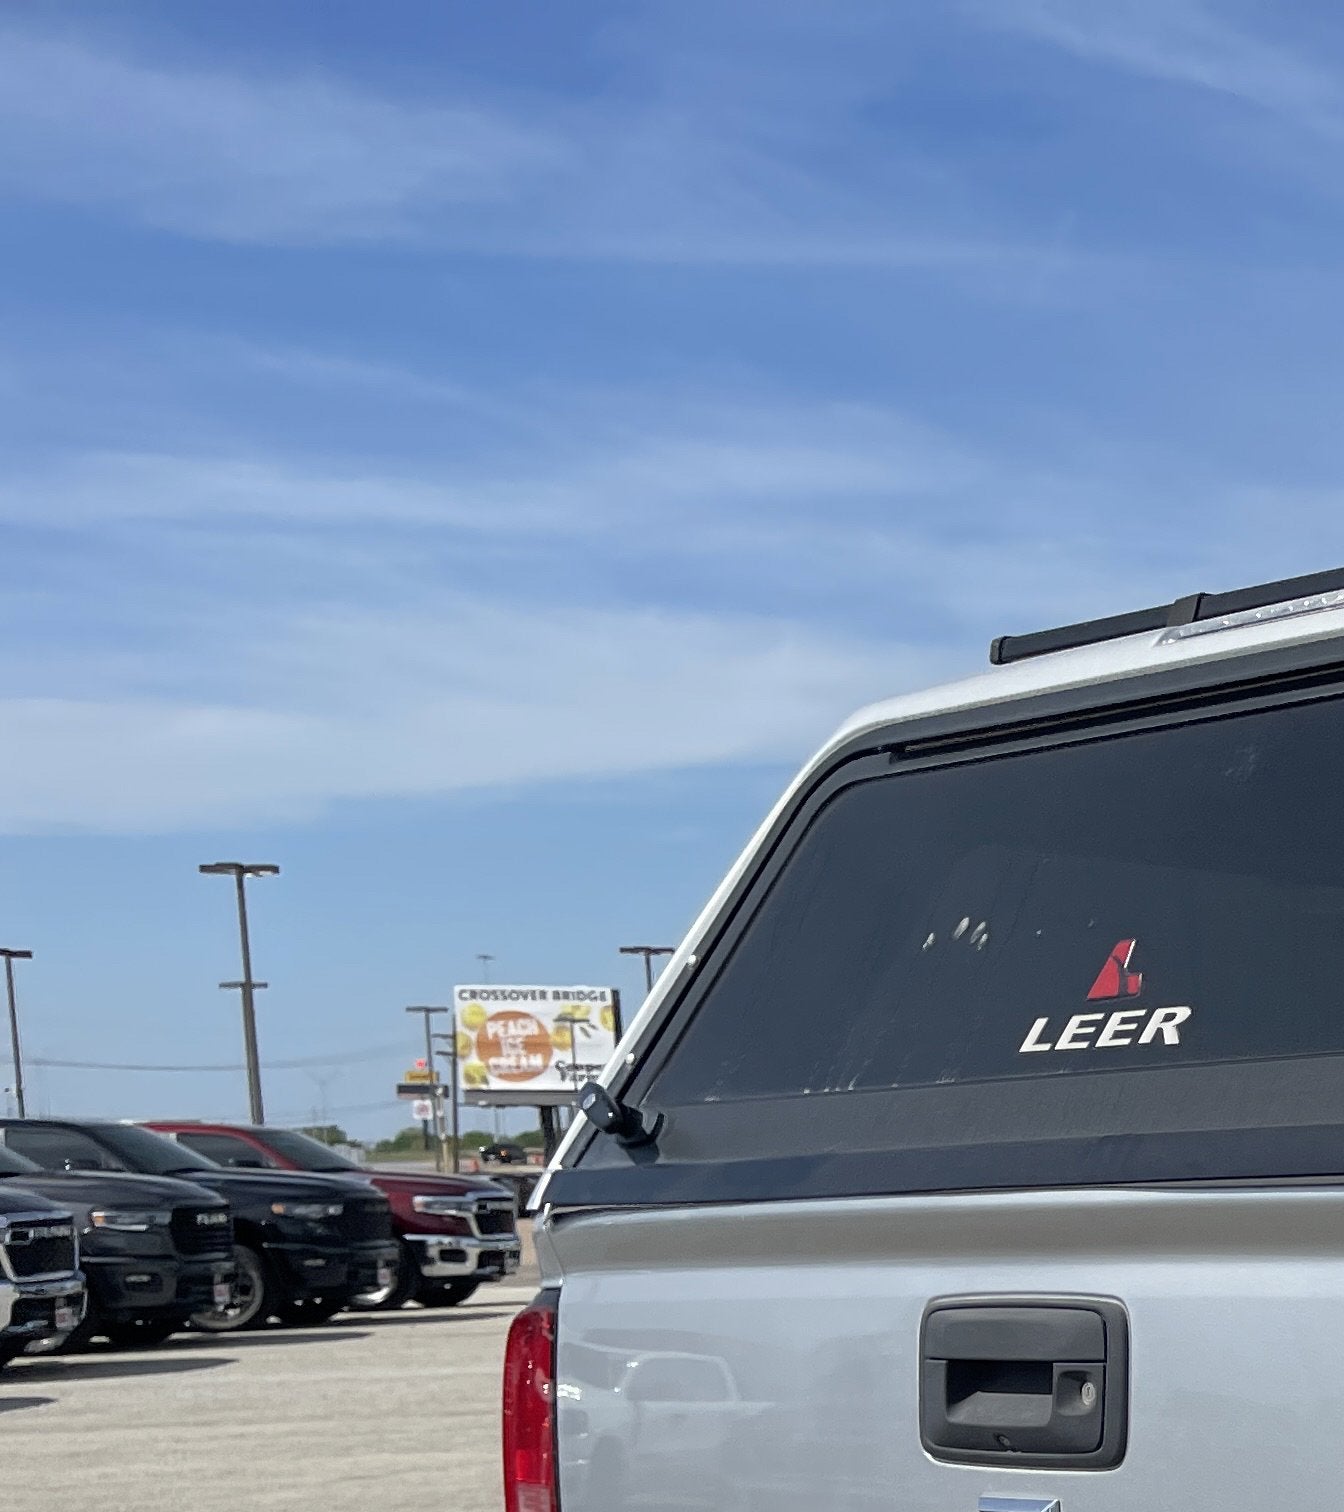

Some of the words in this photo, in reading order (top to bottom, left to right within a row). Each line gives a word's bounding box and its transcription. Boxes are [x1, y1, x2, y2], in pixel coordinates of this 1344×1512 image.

[458, 989, 547, 1001] CROSSOVER
[552, 990, 607, 1001] BRIDGE
[486, 1018, 540, 1040] PEACH
[1019, 1005, 1192, 1053] LEER
